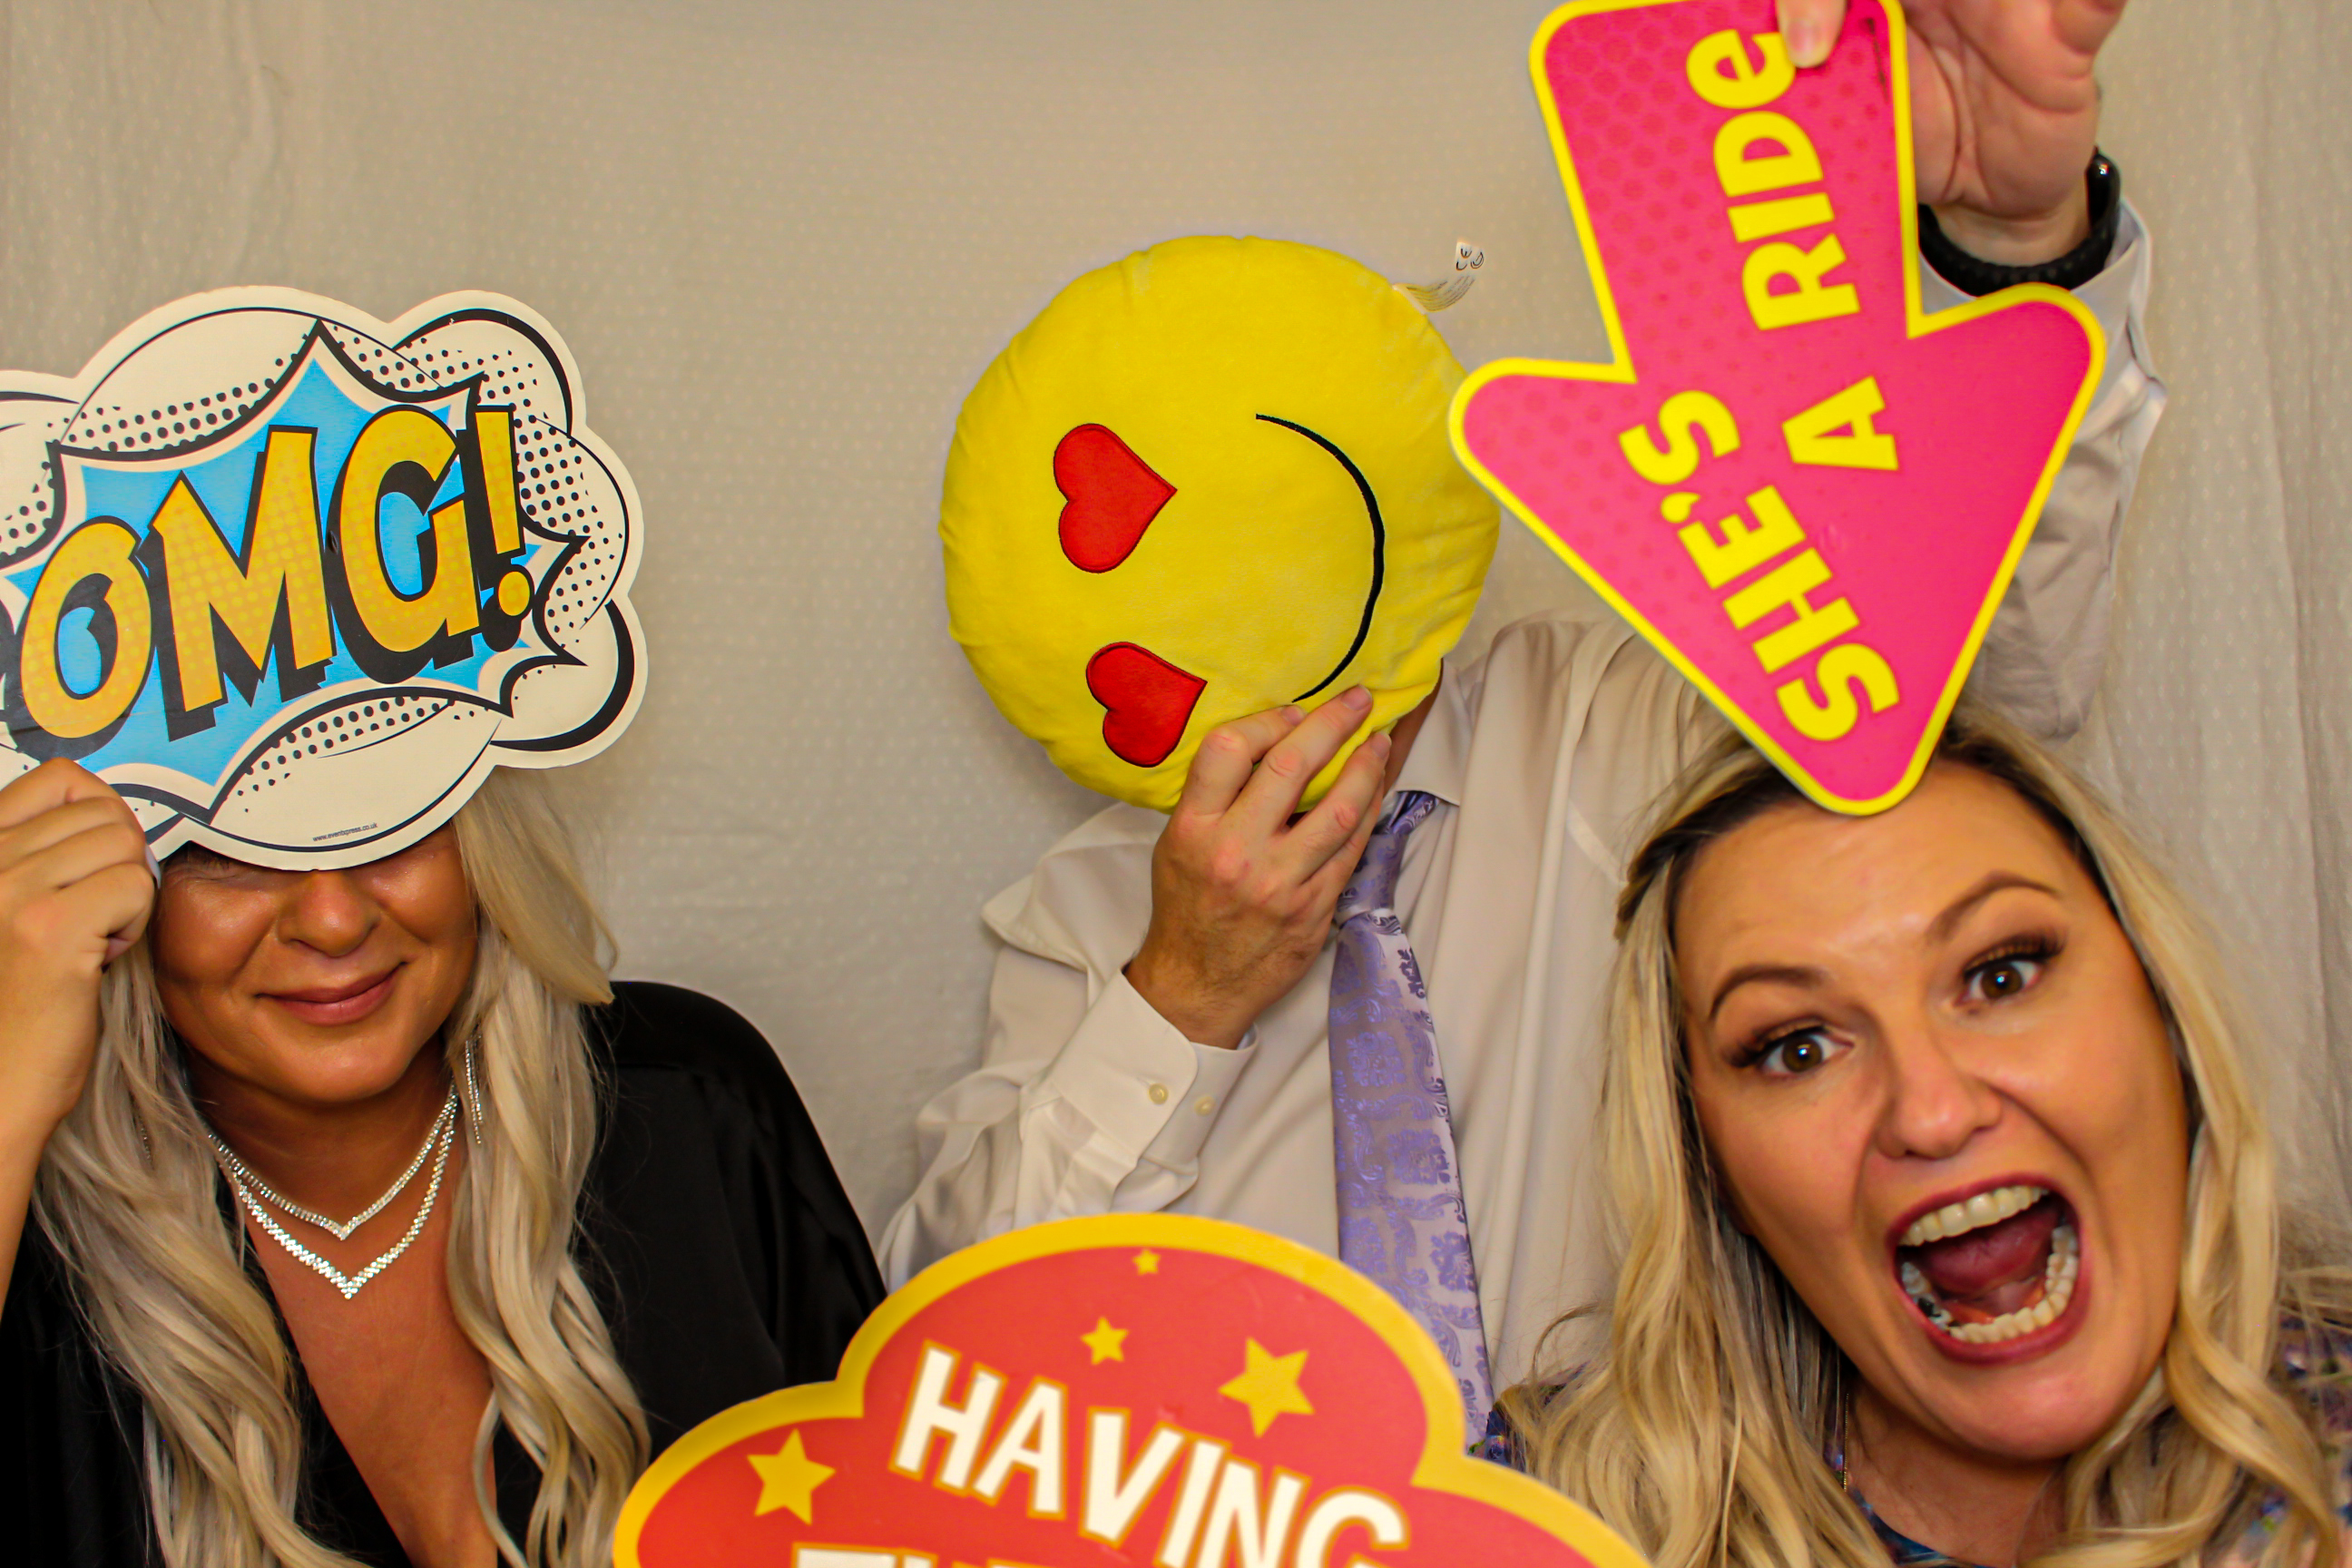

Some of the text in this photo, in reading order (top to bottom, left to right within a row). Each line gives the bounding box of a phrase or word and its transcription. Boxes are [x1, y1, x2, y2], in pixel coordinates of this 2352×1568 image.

[1781, 376, 1899, 472] A
[18, 403, 535, 742] OMG!
[1617, 389, 1900, 742] SHE'S
[897, 1345, 1406, 1568] HAVING
